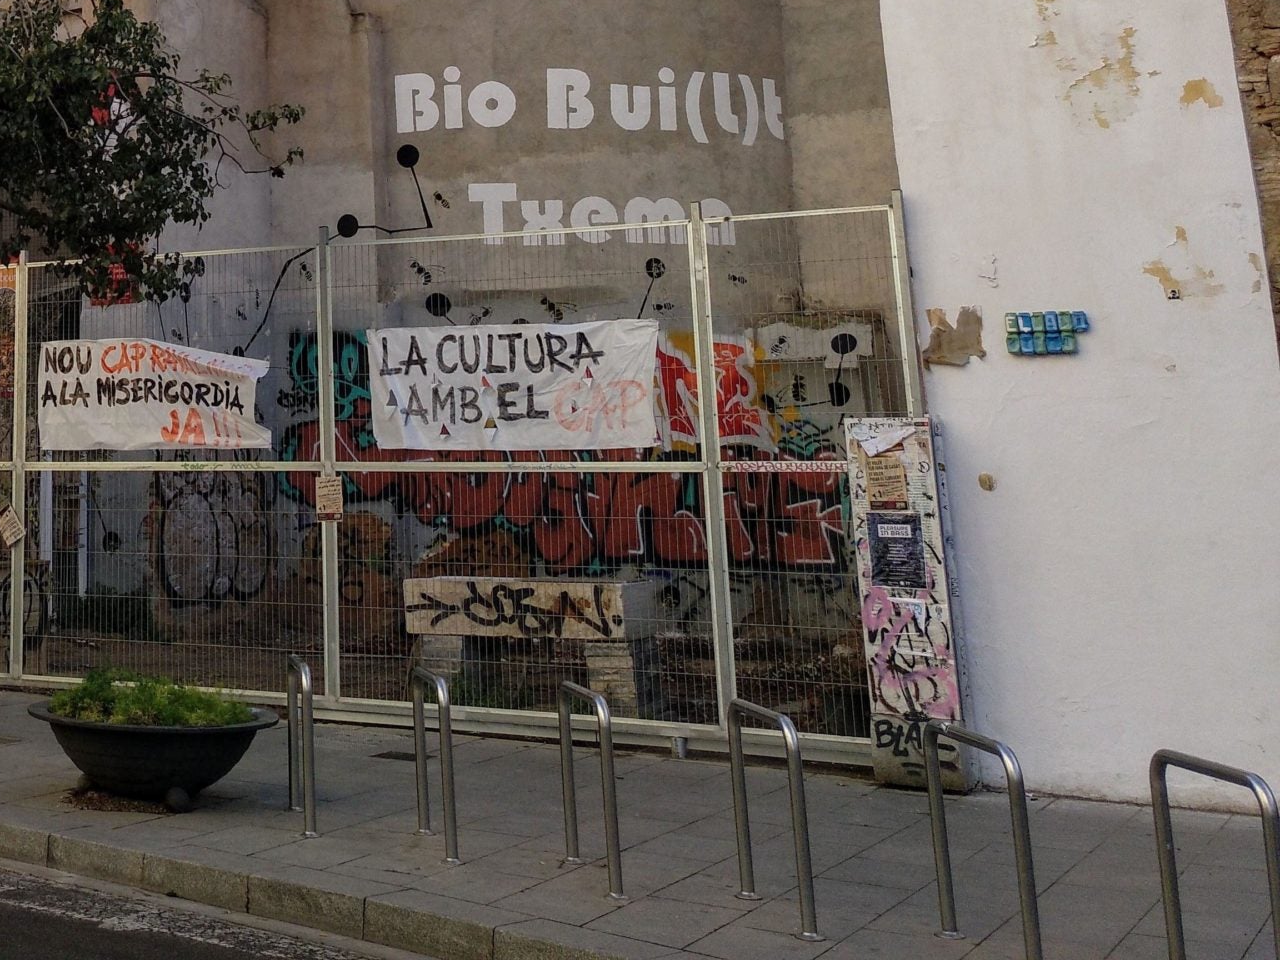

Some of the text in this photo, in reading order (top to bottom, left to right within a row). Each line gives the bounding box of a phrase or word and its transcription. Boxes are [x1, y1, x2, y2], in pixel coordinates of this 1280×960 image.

[395, 66, 516, 133] Bio
[44, 345, 93, 375] NOU
[101, 342, 146, 375] CAP
[380, 331, 605, 377] LA CULTURA
[400, 384, 482, 426] AMB
[497, 382, 549, 421] EL
